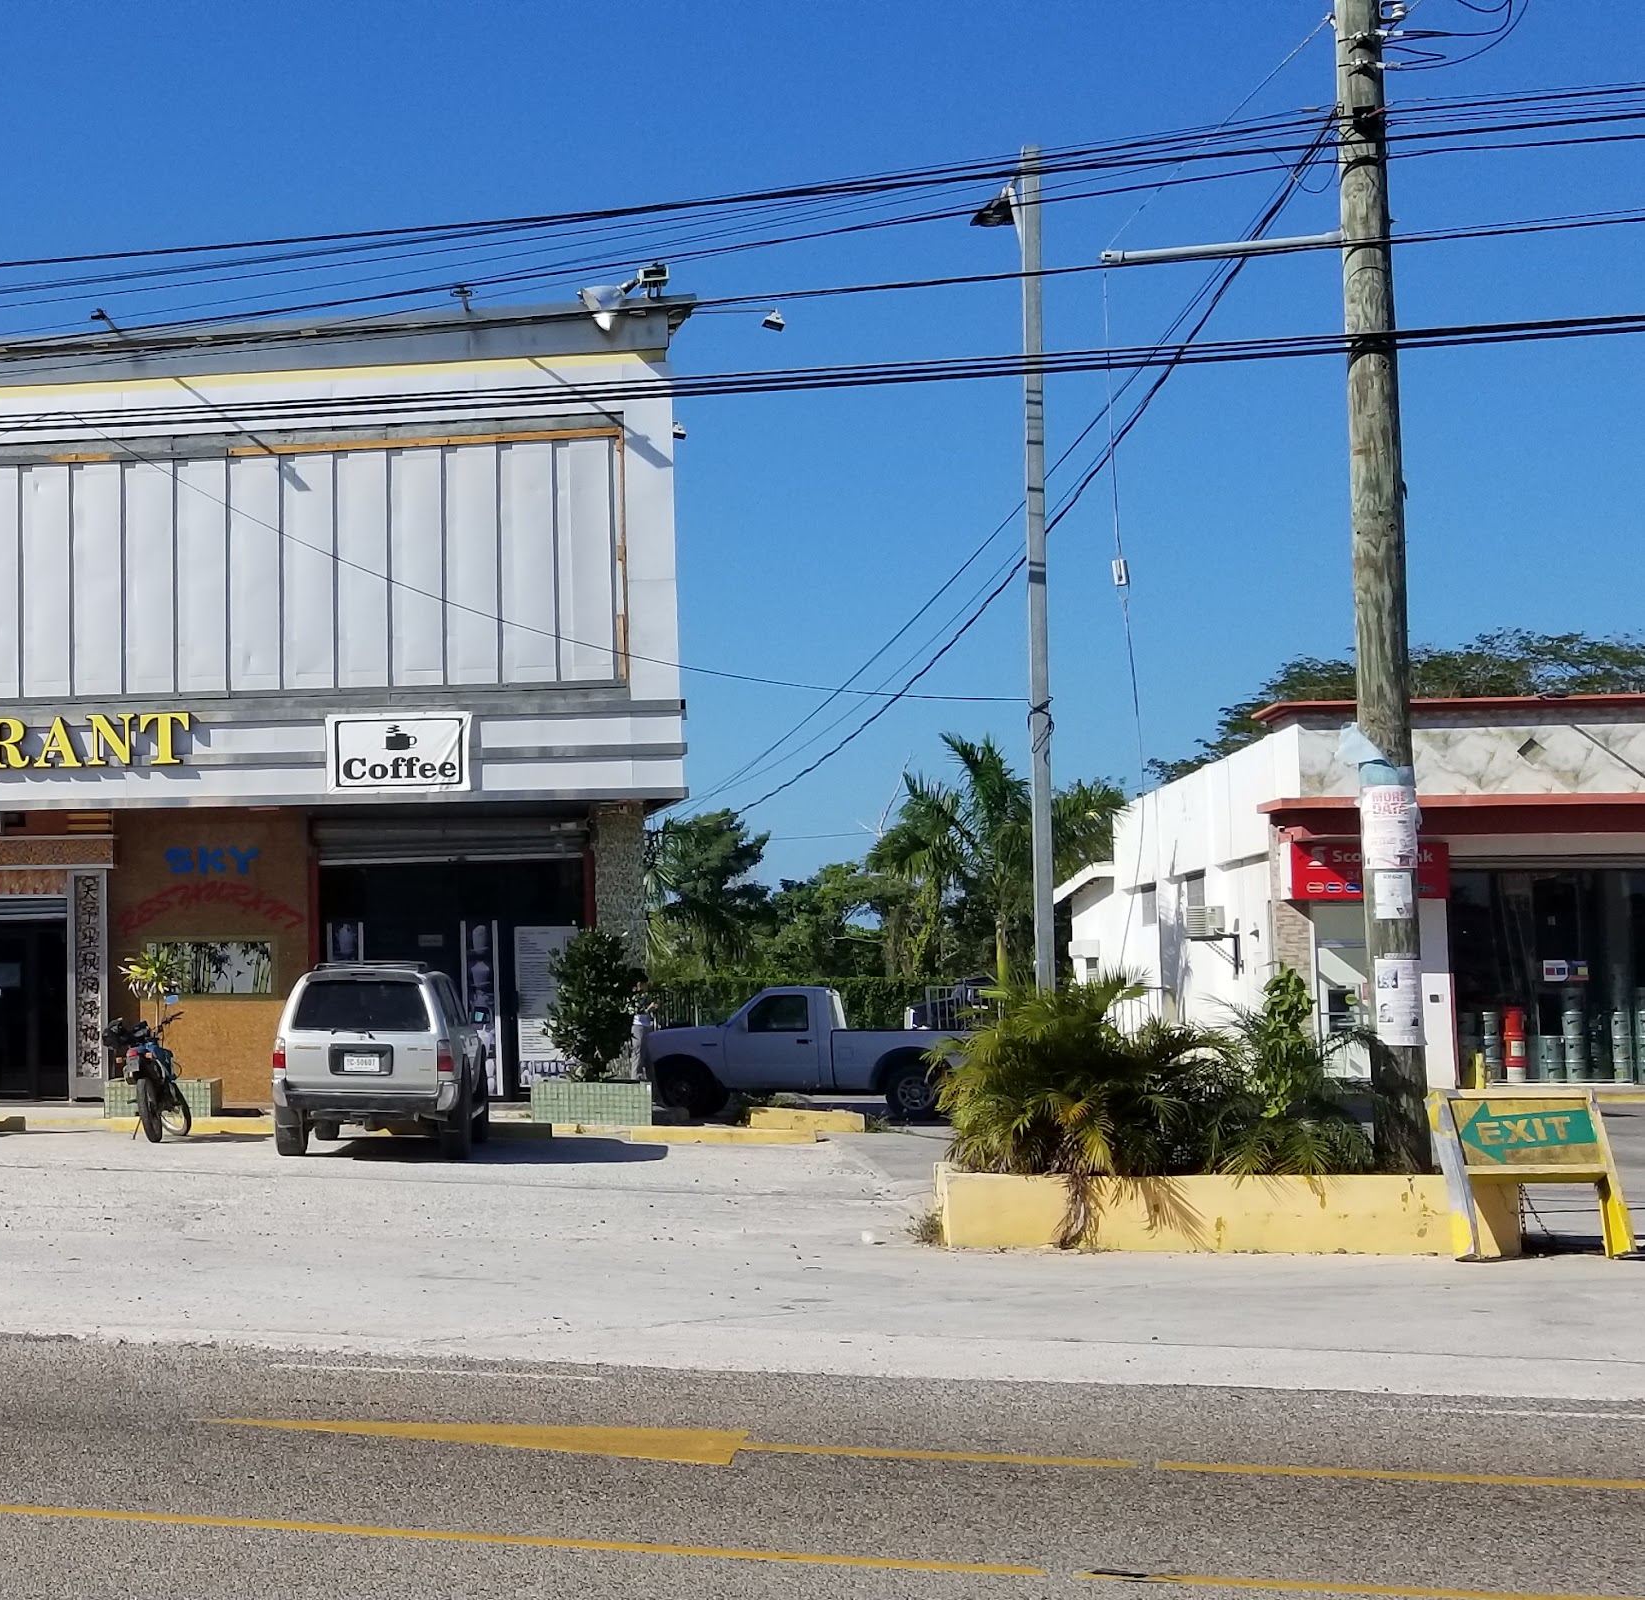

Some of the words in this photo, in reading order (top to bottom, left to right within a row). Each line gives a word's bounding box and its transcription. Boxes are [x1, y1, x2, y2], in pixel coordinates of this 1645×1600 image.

[343, 756, 458, 781] Coffee
[163, 847, 260, 875] SKY
[1476, 1116, 1570, 1145] EXIT
